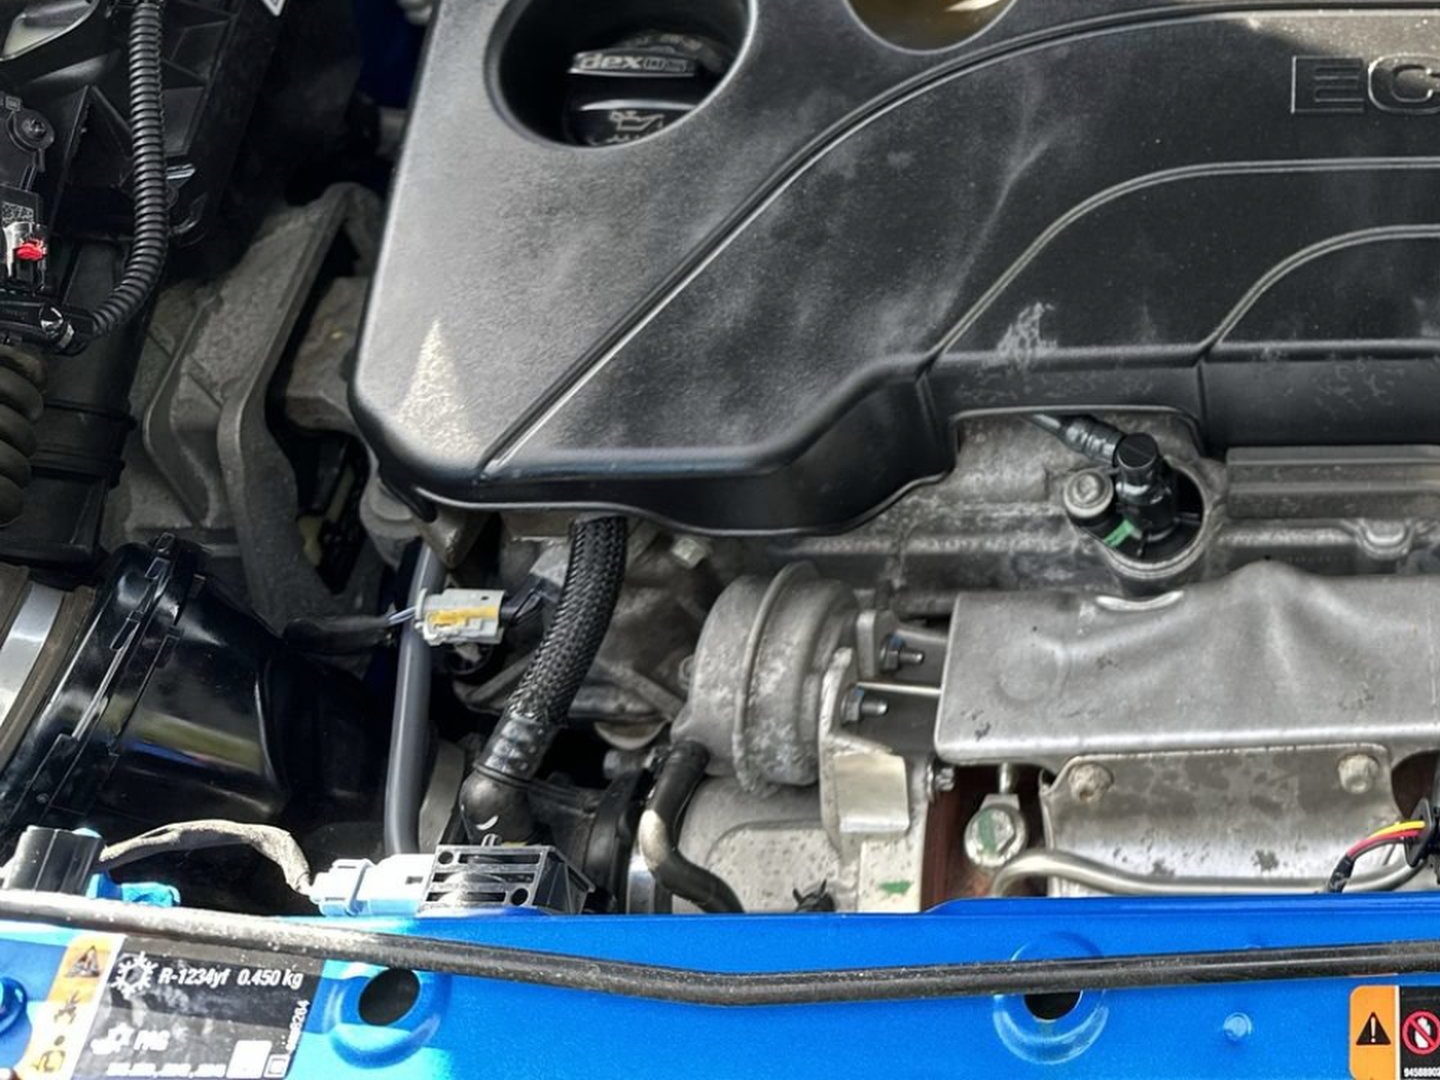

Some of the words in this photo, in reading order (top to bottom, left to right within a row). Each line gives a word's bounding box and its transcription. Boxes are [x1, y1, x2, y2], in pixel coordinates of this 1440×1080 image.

[579, 52, 689, 72] dexos
[157, 967, 231, 989] R-1234yf
[236, 968, 281, 987] 0.450
[281, 968, 304, 990] kg
